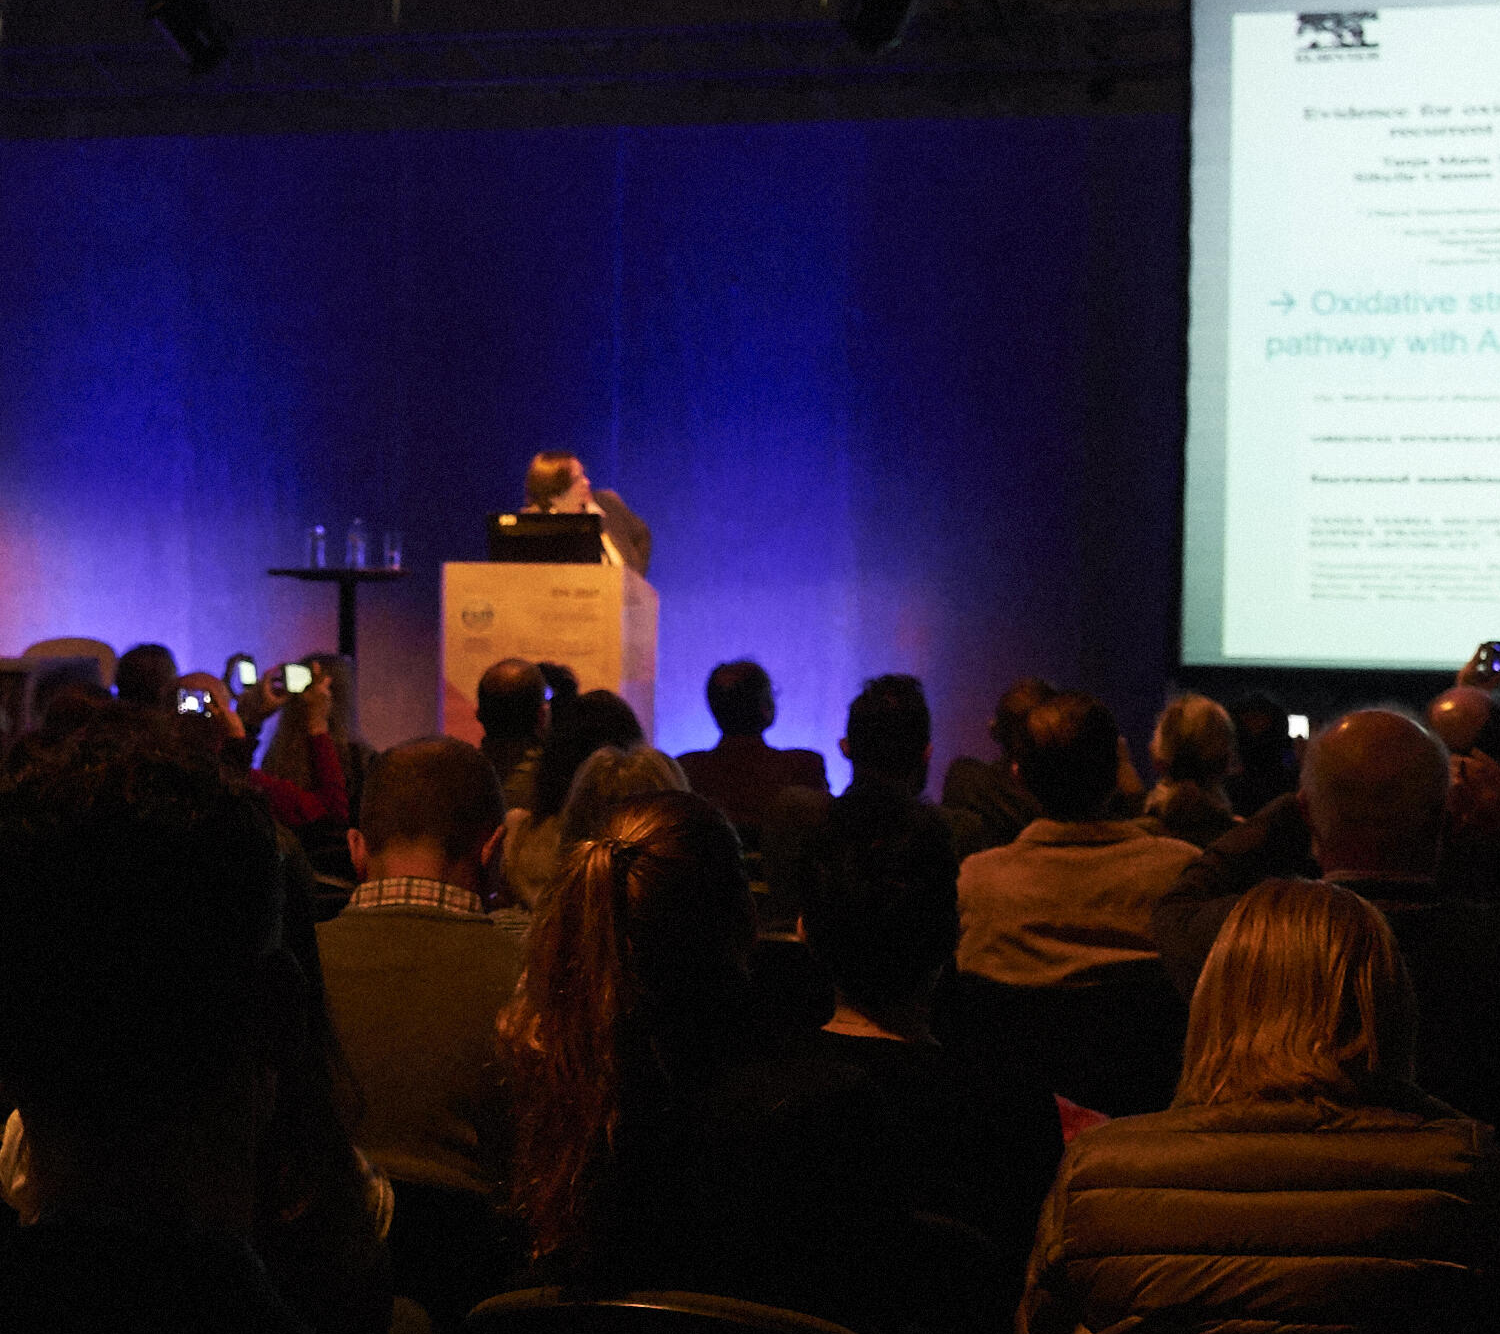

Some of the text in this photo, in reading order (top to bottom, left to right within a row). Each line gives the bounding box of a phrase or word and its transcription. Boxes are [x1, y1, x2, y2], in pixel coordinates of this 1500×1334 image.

[1309, 289, 1458, 316] Oxidative
[1264, 329, 1395, 360] pathway
[1407, 327, 1467, 354] with
